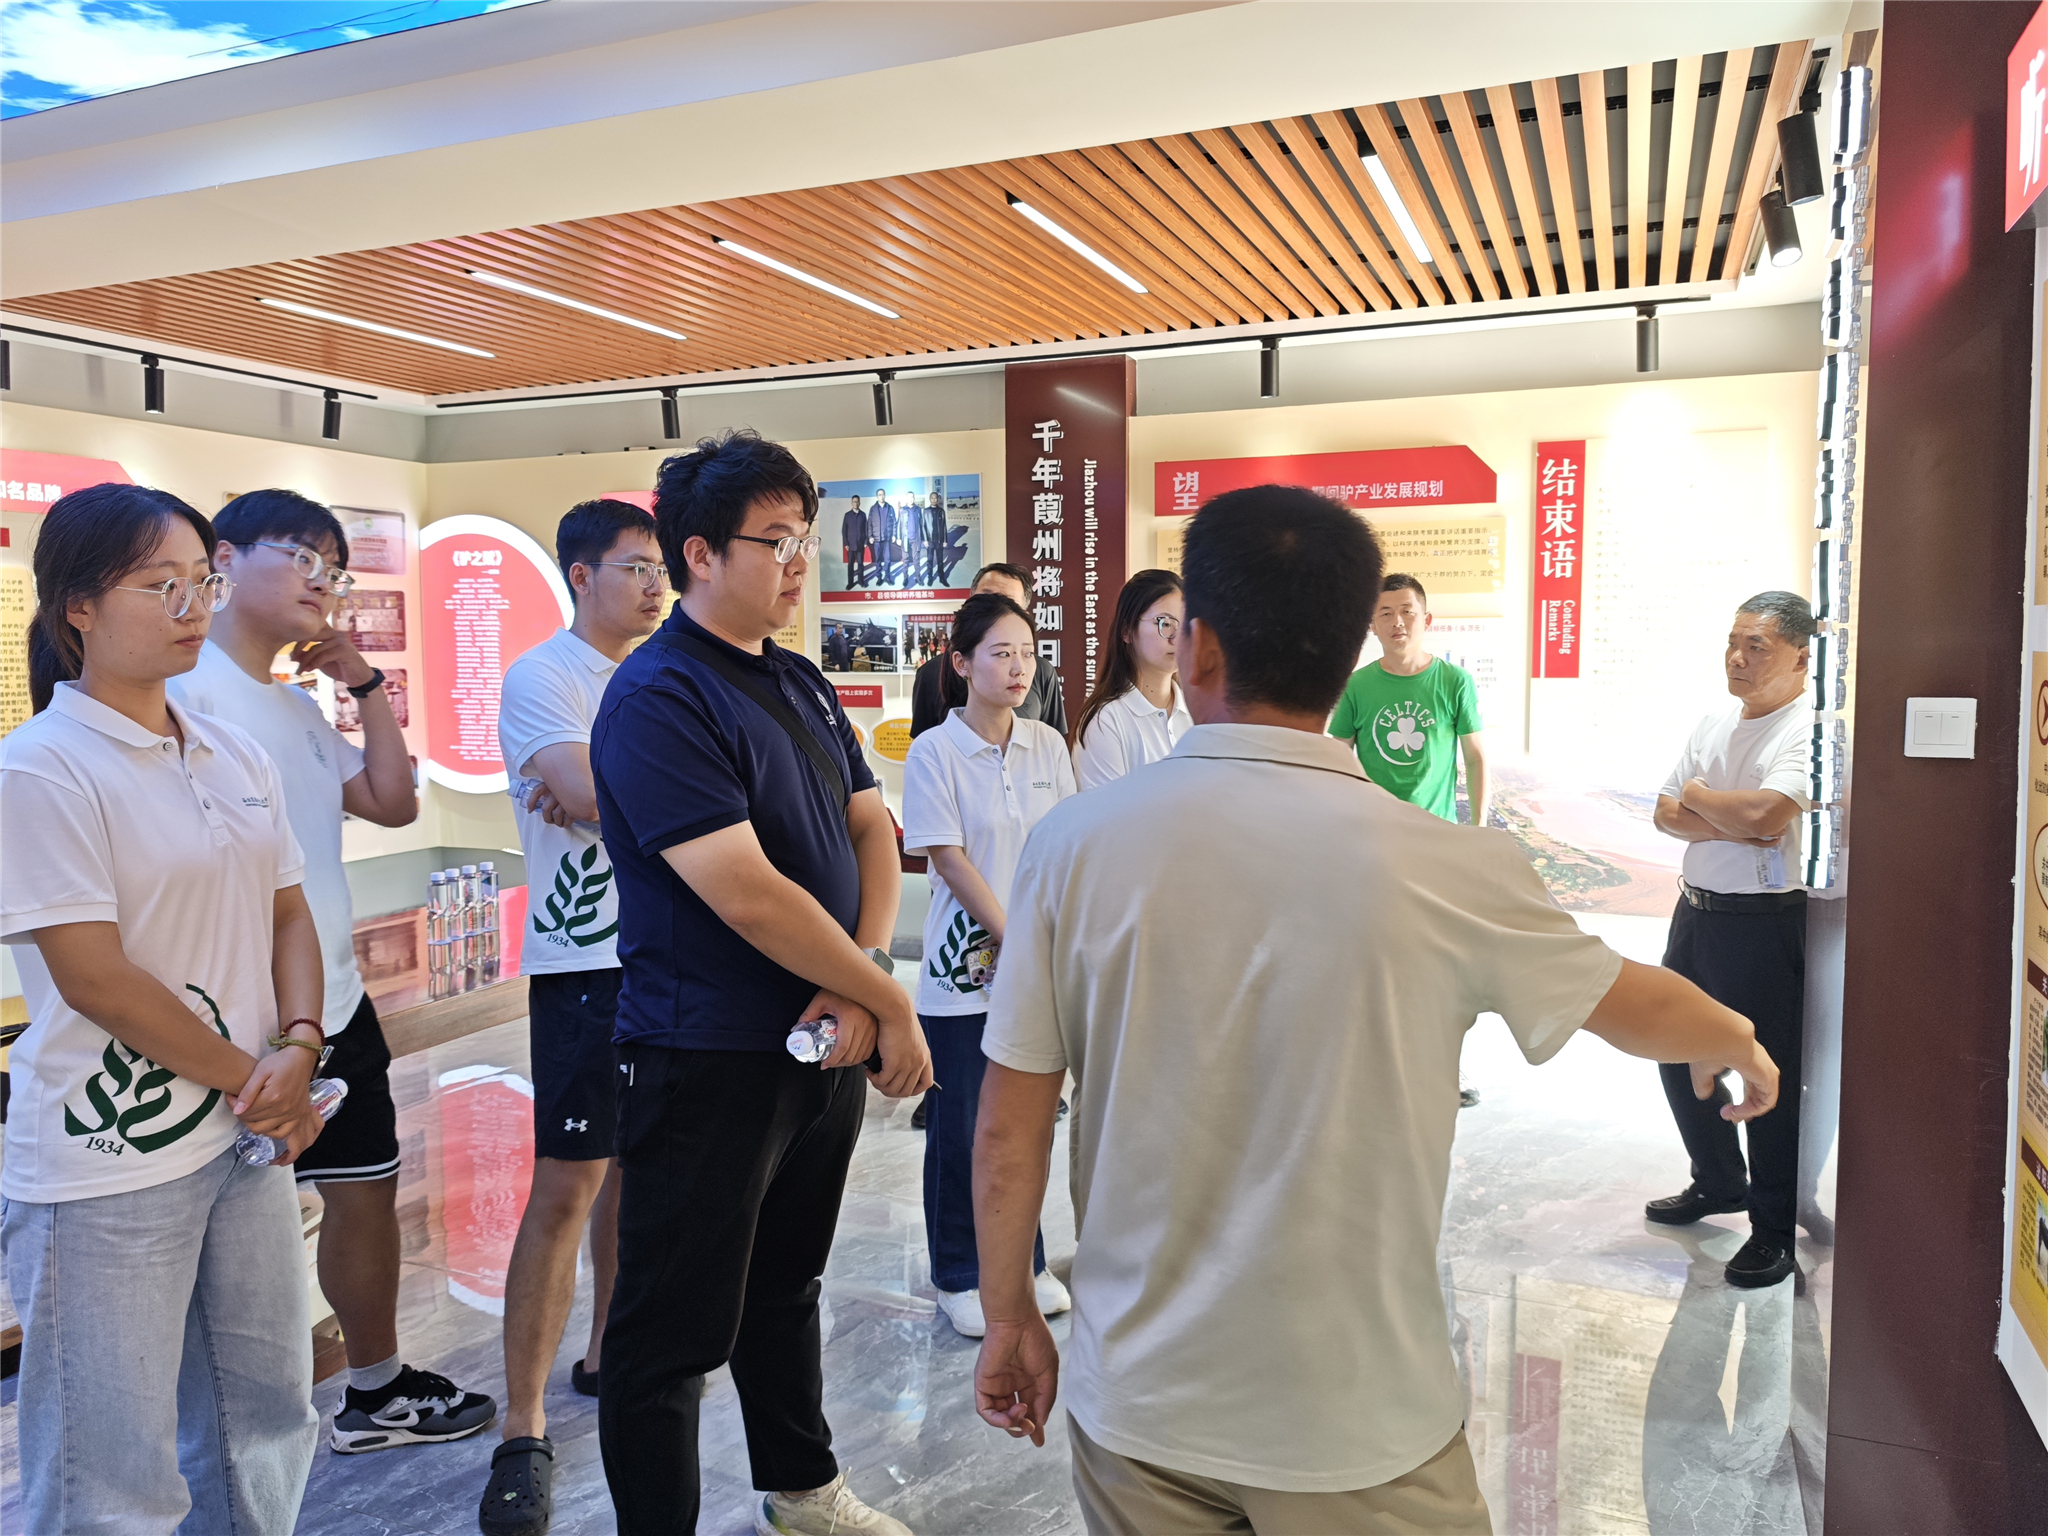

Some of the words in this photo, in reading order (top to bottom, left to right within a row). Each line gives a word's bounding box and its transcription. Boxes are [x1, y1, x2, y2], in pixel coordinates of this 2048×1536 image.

[1084, 458, 1097, 505] Jiazhou
[1084, 507, 1098, 529] will
[1540, 458, 1578, 579] 结束语
[1084, 532, 1098, 554] rise
[1032, 419, 1064, 702] 千年葭州将如日
[1085, 556, 1098, 568] in
[1085, 570, 1098, 591] the
[1085, 593, 1098, 619] East
[1085, 621, 1095, 634] as
[1548, 600, 1561, 641] Remarks
[1559, 600, 1576, 655] Concluding
[1085, 636, 1099, 656] the
[1085, 658, 1096, 680] sun
[1379, 701, 1435, 728] CELTICS
[546, 933, 570, 948] 1934
[936, 978, 954, 993] 1934
[84, 1135, 125, 1157] 1934
